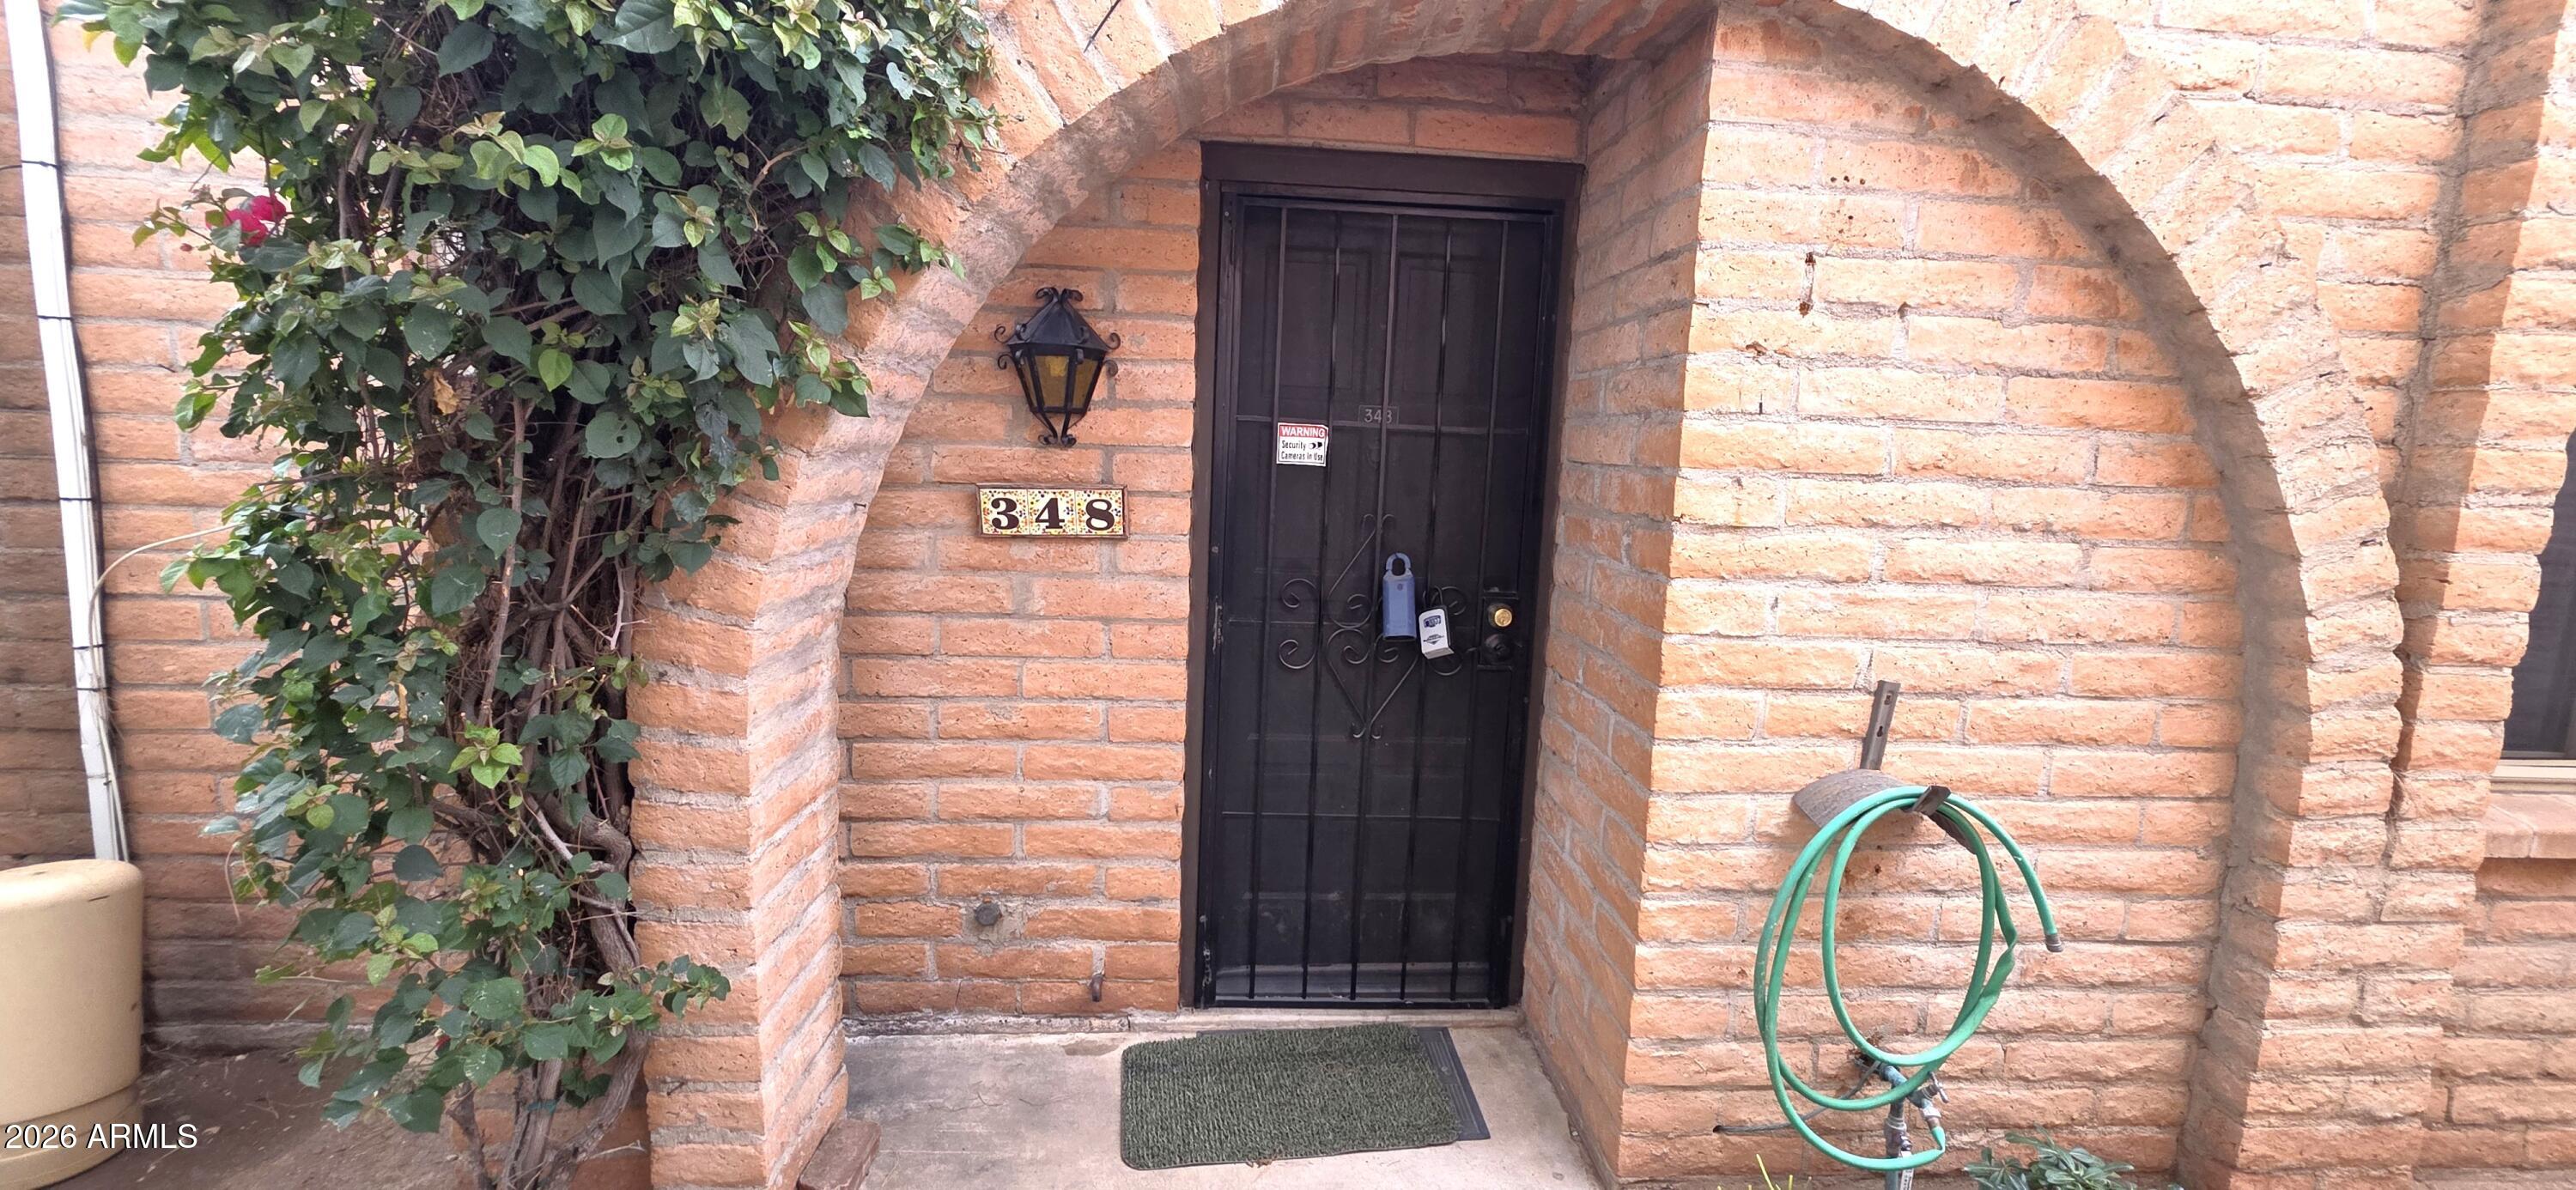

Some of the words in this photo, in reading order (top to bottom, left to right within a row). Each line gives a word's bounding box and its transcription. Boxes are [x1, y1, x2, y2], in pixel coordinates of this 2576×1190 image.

[1281, 426, 1325, 438] WARNING
[1281, 440, 1306, 451] Security
[1281, 451, 1305, 460] Cameras
[1314, 452, 1323, 461] Use
[991, 497, 1115, 531] 348
